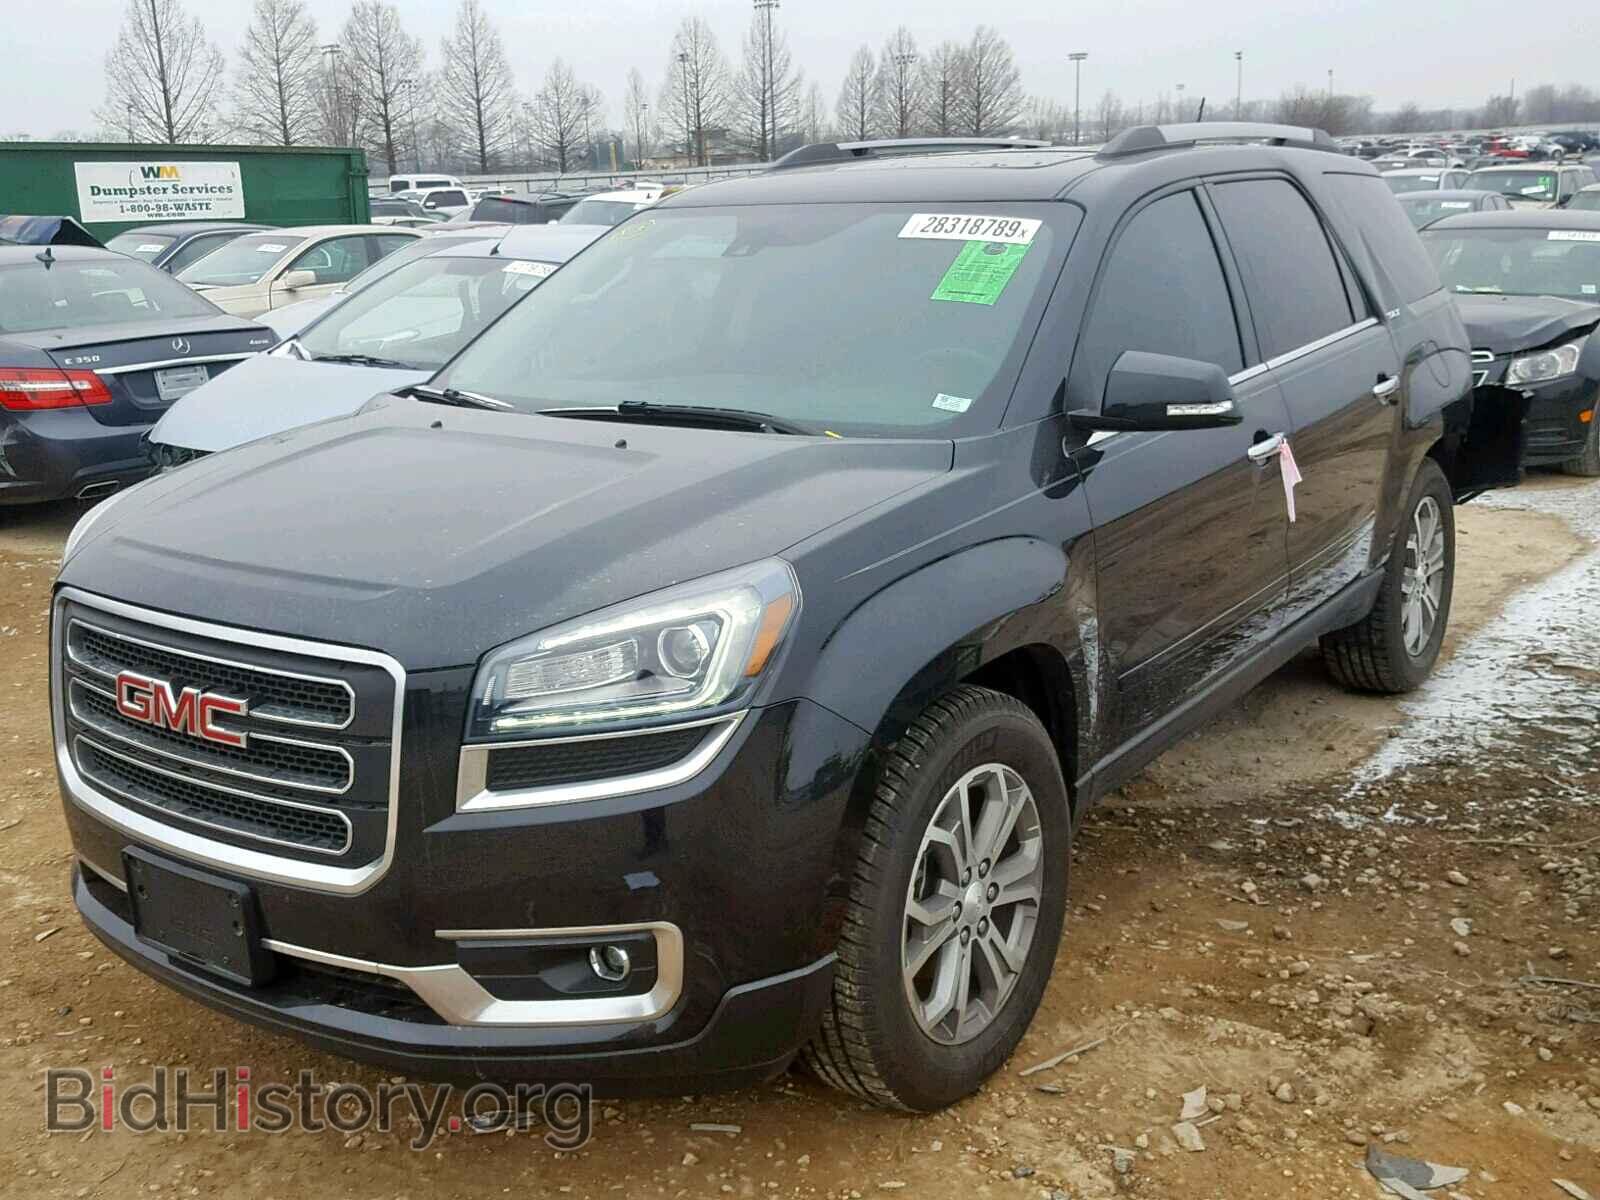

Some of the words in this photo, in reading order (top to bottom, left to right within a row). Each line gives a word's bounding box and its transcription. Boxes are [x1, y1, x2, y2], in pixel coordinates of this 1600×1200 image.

[140, 166, 179, 178] WM
[90, 185, 168, 198] Dumpster
[171, 183, 233, 195] Services
[119, 202, 212, 213] 1-800-98-WASTE
[75, 355, 100, 364] 350
[115, 670, 249, 749] GMC
